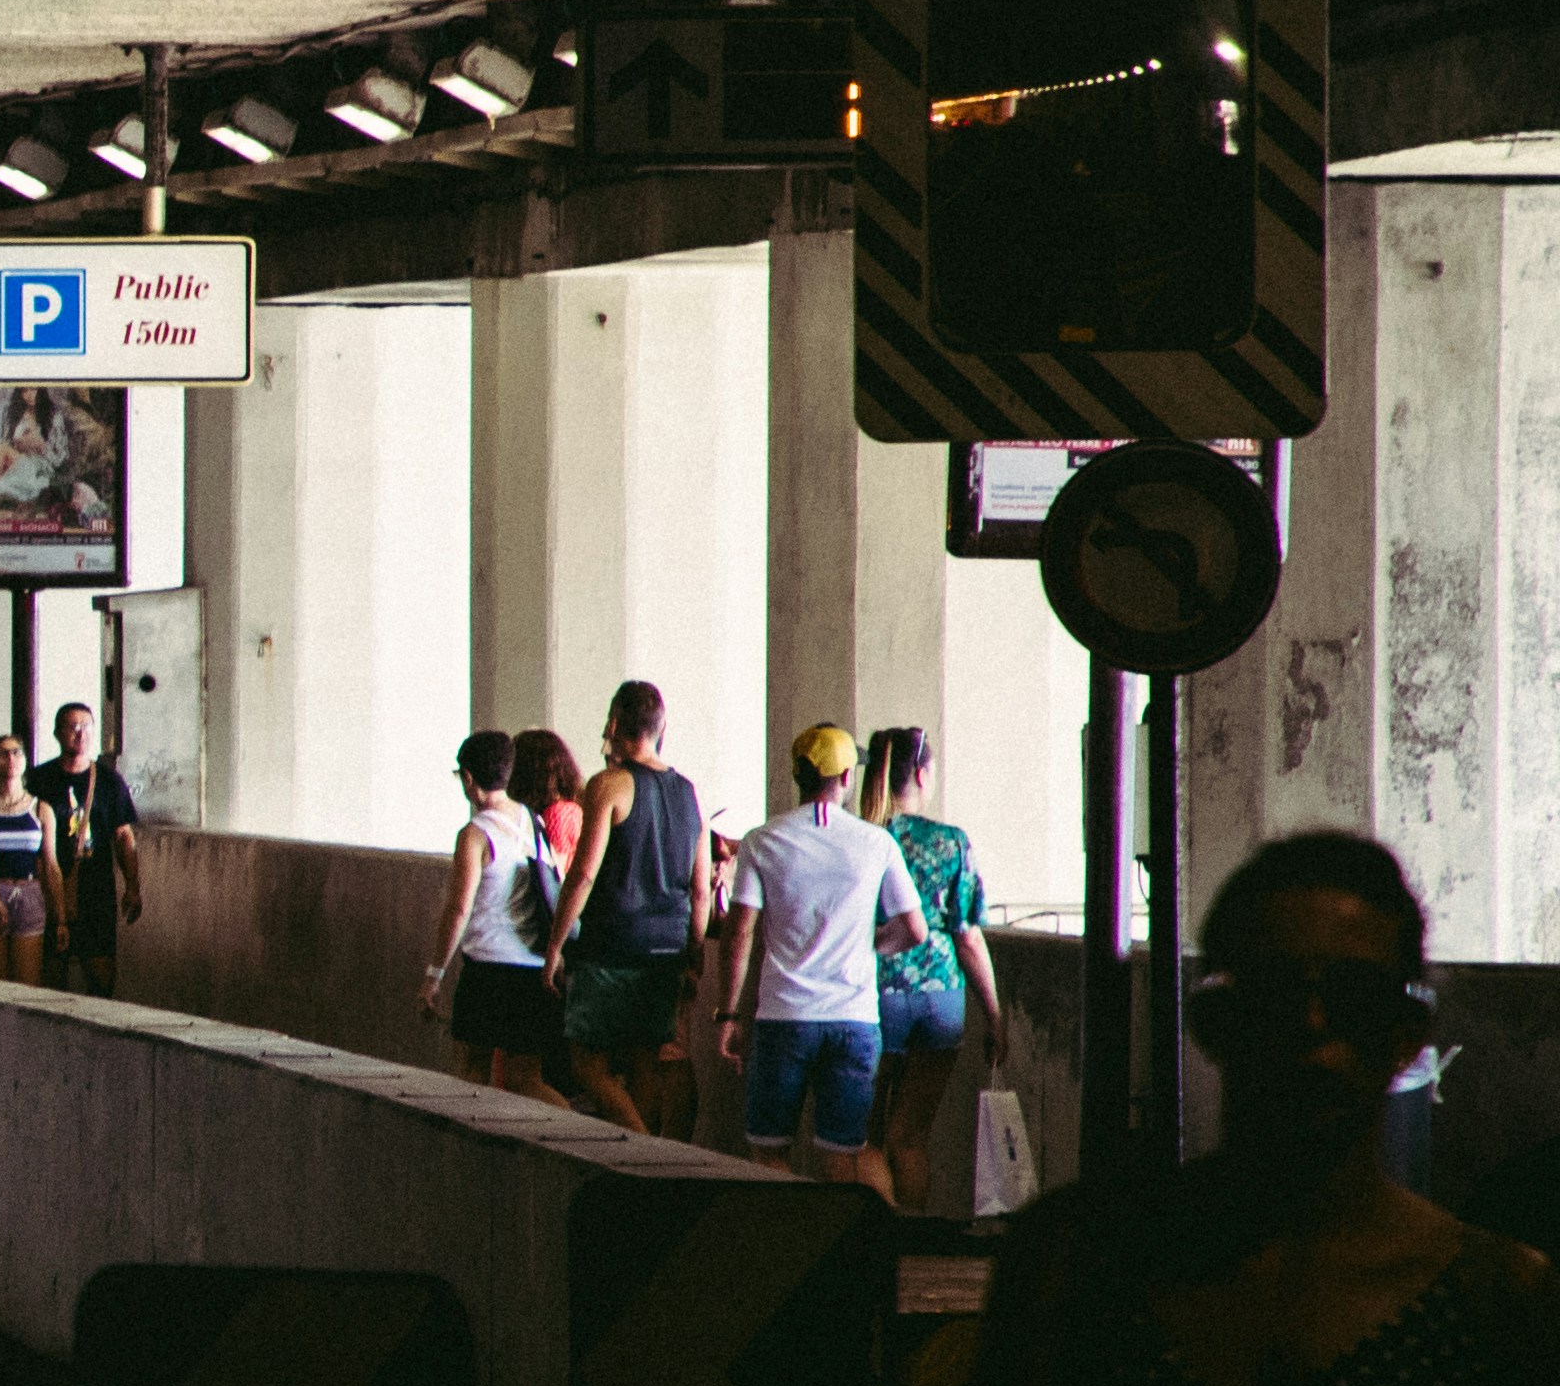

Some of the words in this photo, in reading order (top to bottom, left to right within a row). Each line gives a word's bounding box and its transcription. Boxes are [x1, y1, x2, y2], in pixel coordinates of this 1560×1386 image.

[113, 274, 210, 301] Public
[21, 283, 63, 342] P
[122, 320, 198, 346] 150m
